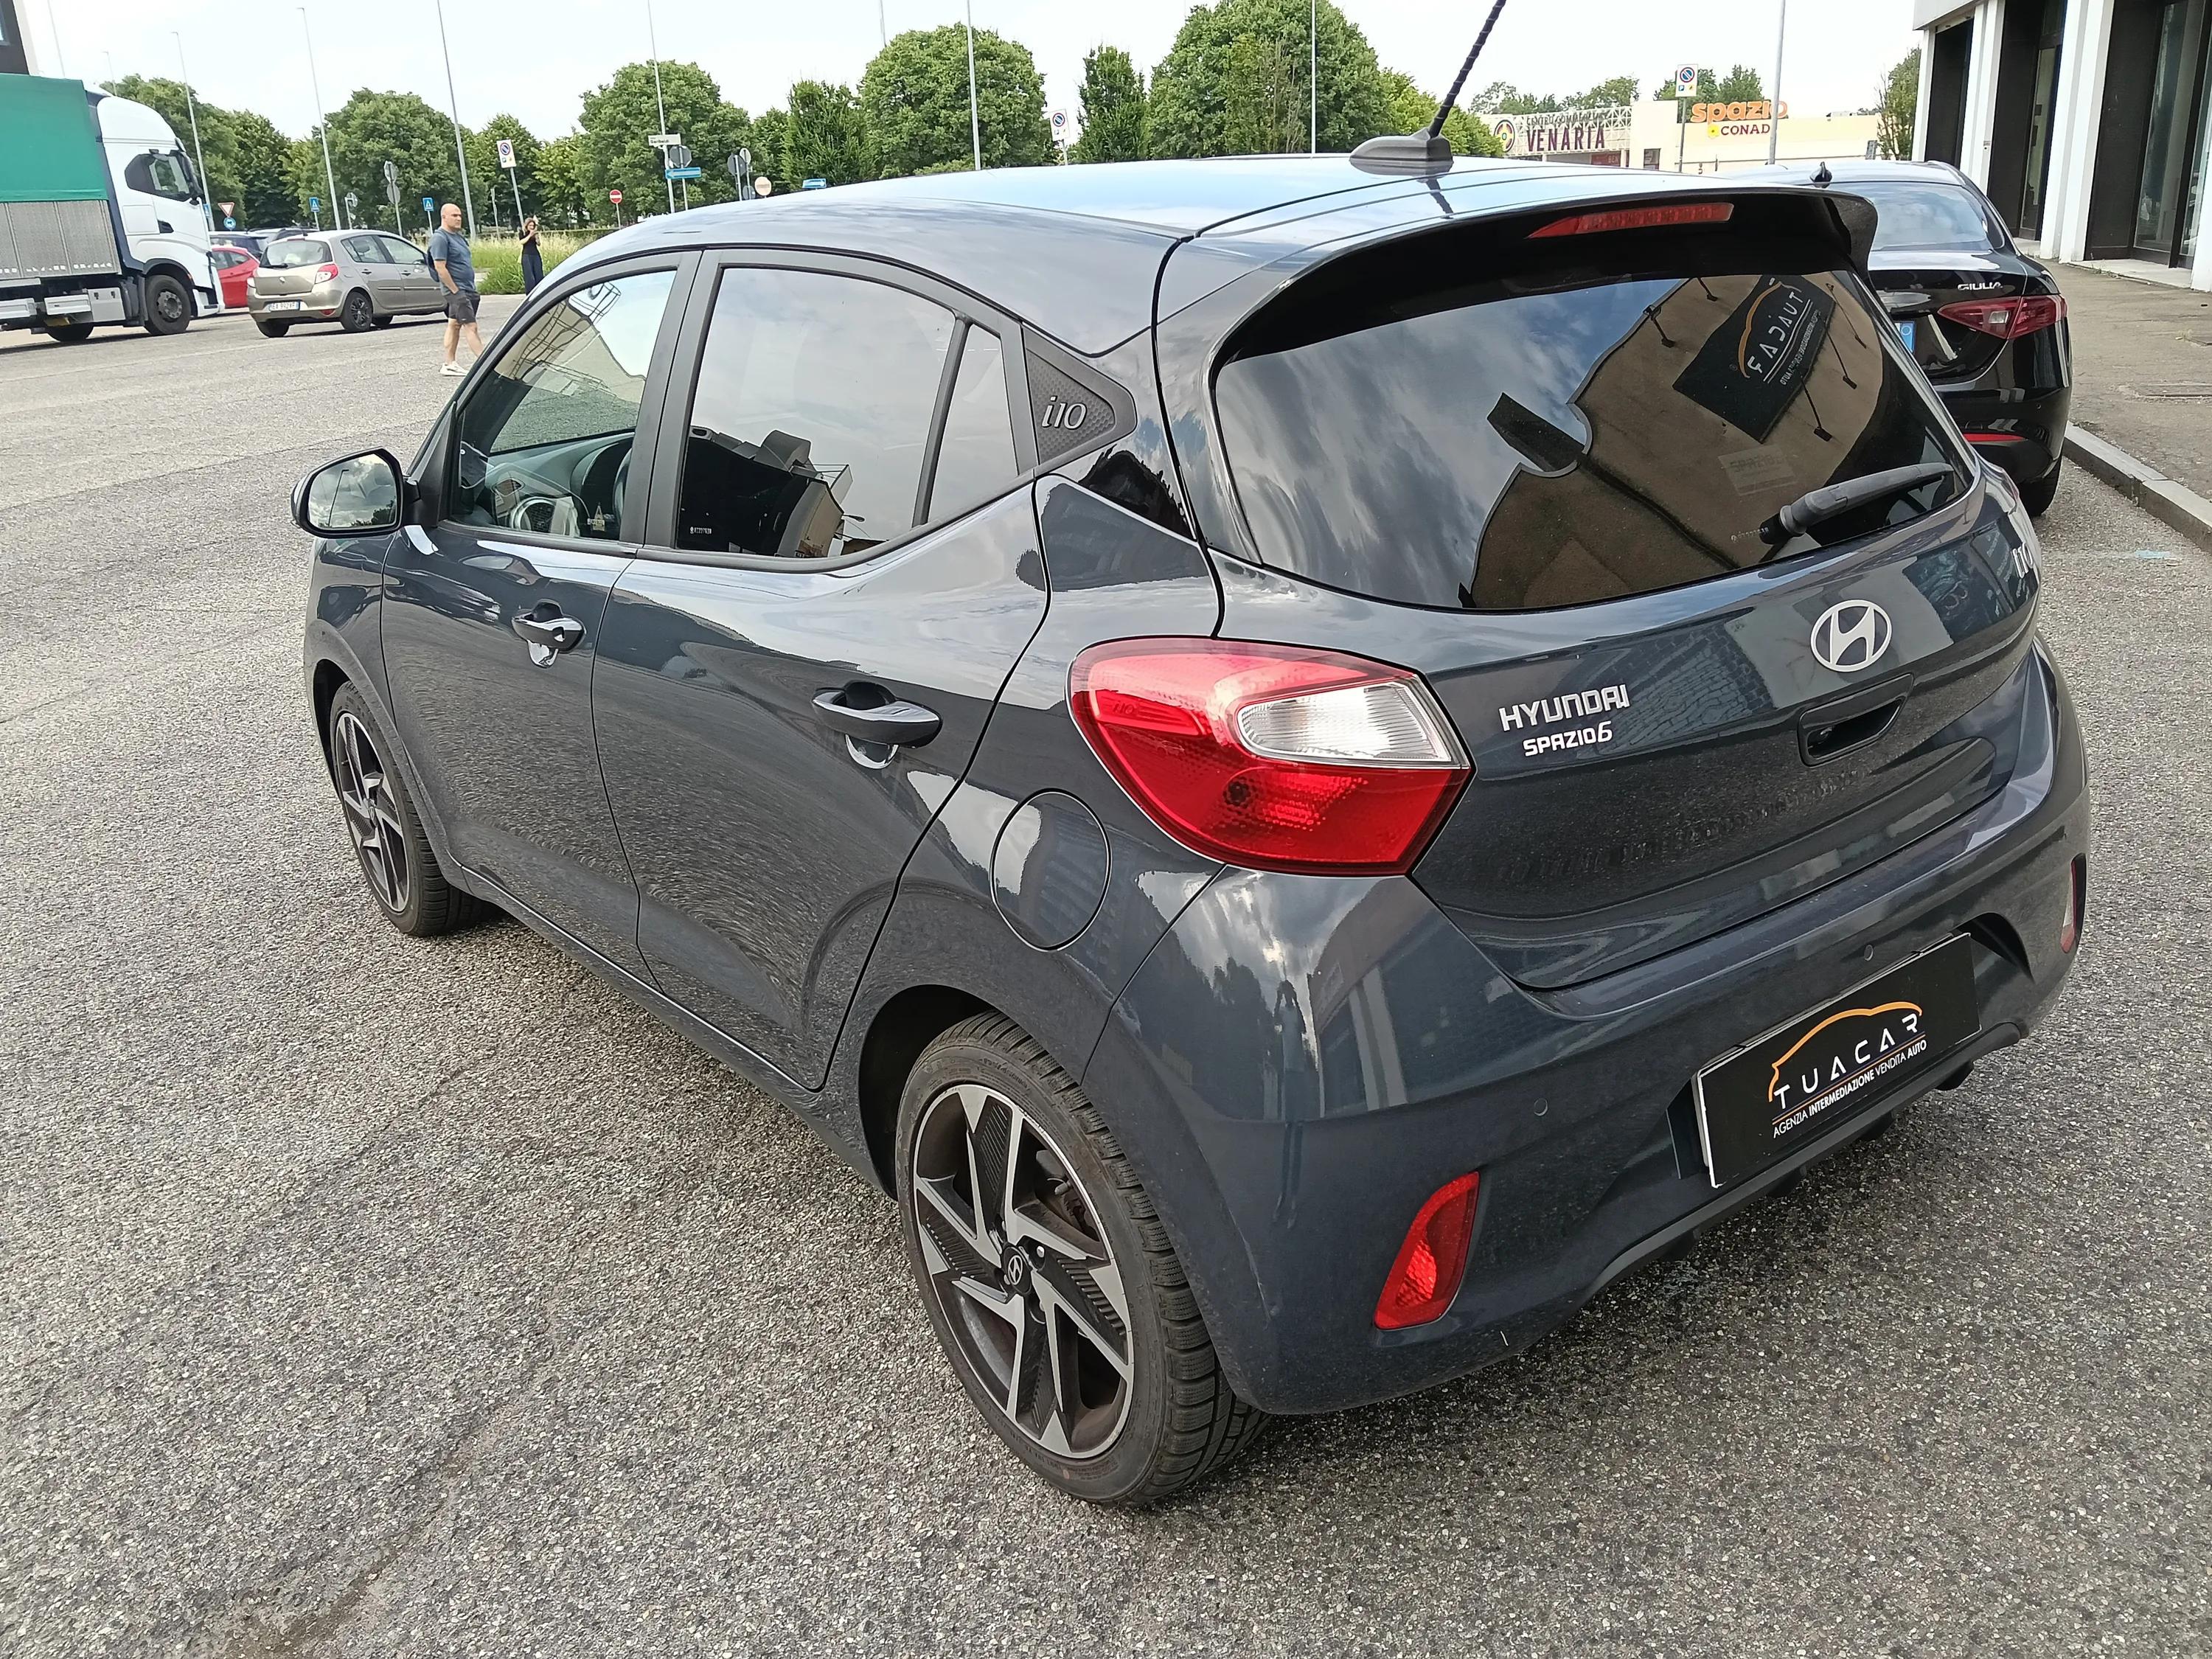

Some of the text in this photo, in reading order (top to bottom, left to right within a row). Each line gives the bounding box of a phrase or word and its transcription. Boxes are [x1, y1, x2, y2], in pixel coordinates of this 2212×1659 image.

[1690, 100, 1788, 125] spazio
[1527, 125, 1605, 152] VENARIA
[1720, 123, 1770, 136] CONAD
[1958, 282, 2003, 291] GIULIA
[1041, 395, 1088, 430] i10
[1498, 684, 1630, 731] HYUNDAI
[1773, 1013, 1918, 1110] TUACAR
[1773, 1039, 1927, 1138] AGENZIA INTERMEDIAZIONE VENDITA AUTO
